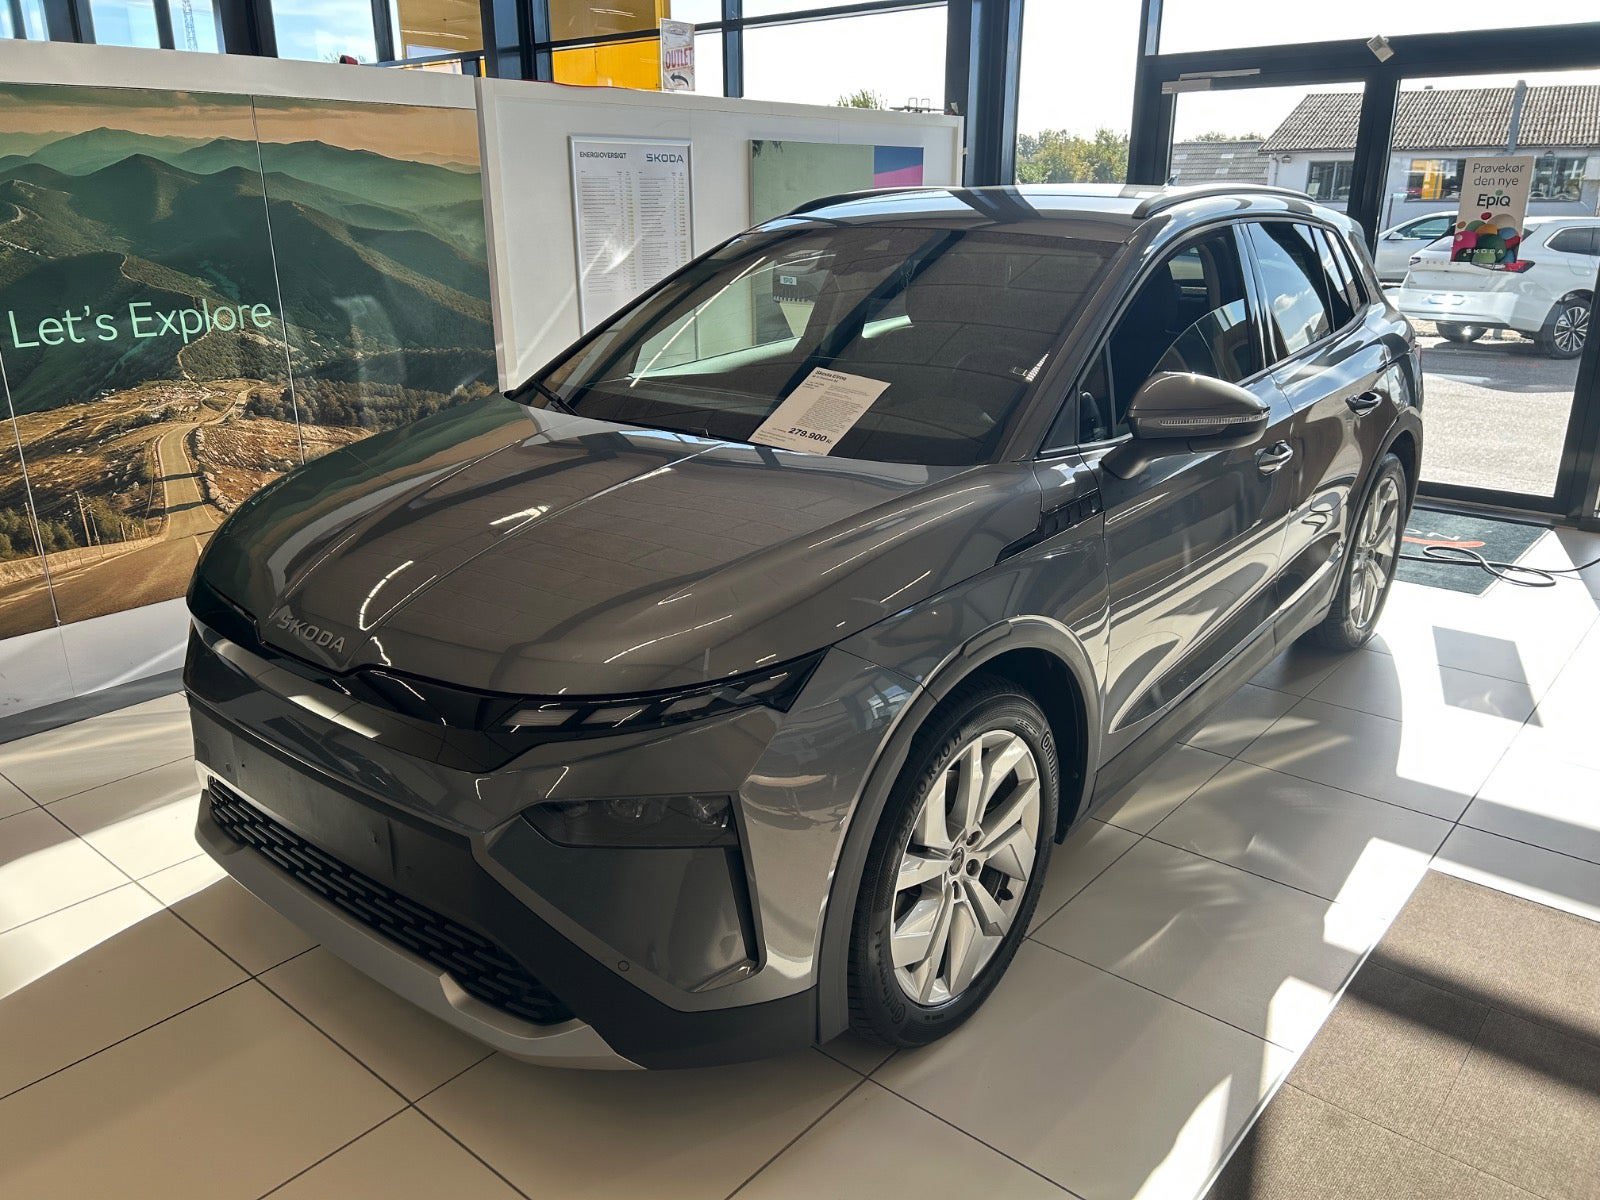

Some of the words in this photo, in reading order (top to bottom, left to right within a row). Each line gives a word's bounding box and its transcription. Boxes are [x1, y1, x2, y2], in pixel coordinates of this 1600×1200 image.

[665, 47, 693, 69] OUTLET
[579, 151, 627, 159] ENERGIOVERSIGT
[1472, 162, 1525, 174] Prøvekør
[1473, 176, 1495, 186] den
[1497, 178, 1519, 188] nye
[1476, 190, 1511, 209] EpiQ
[128, 298, 272, 344] Explore
[787, 427, 828, 442] 279.900
